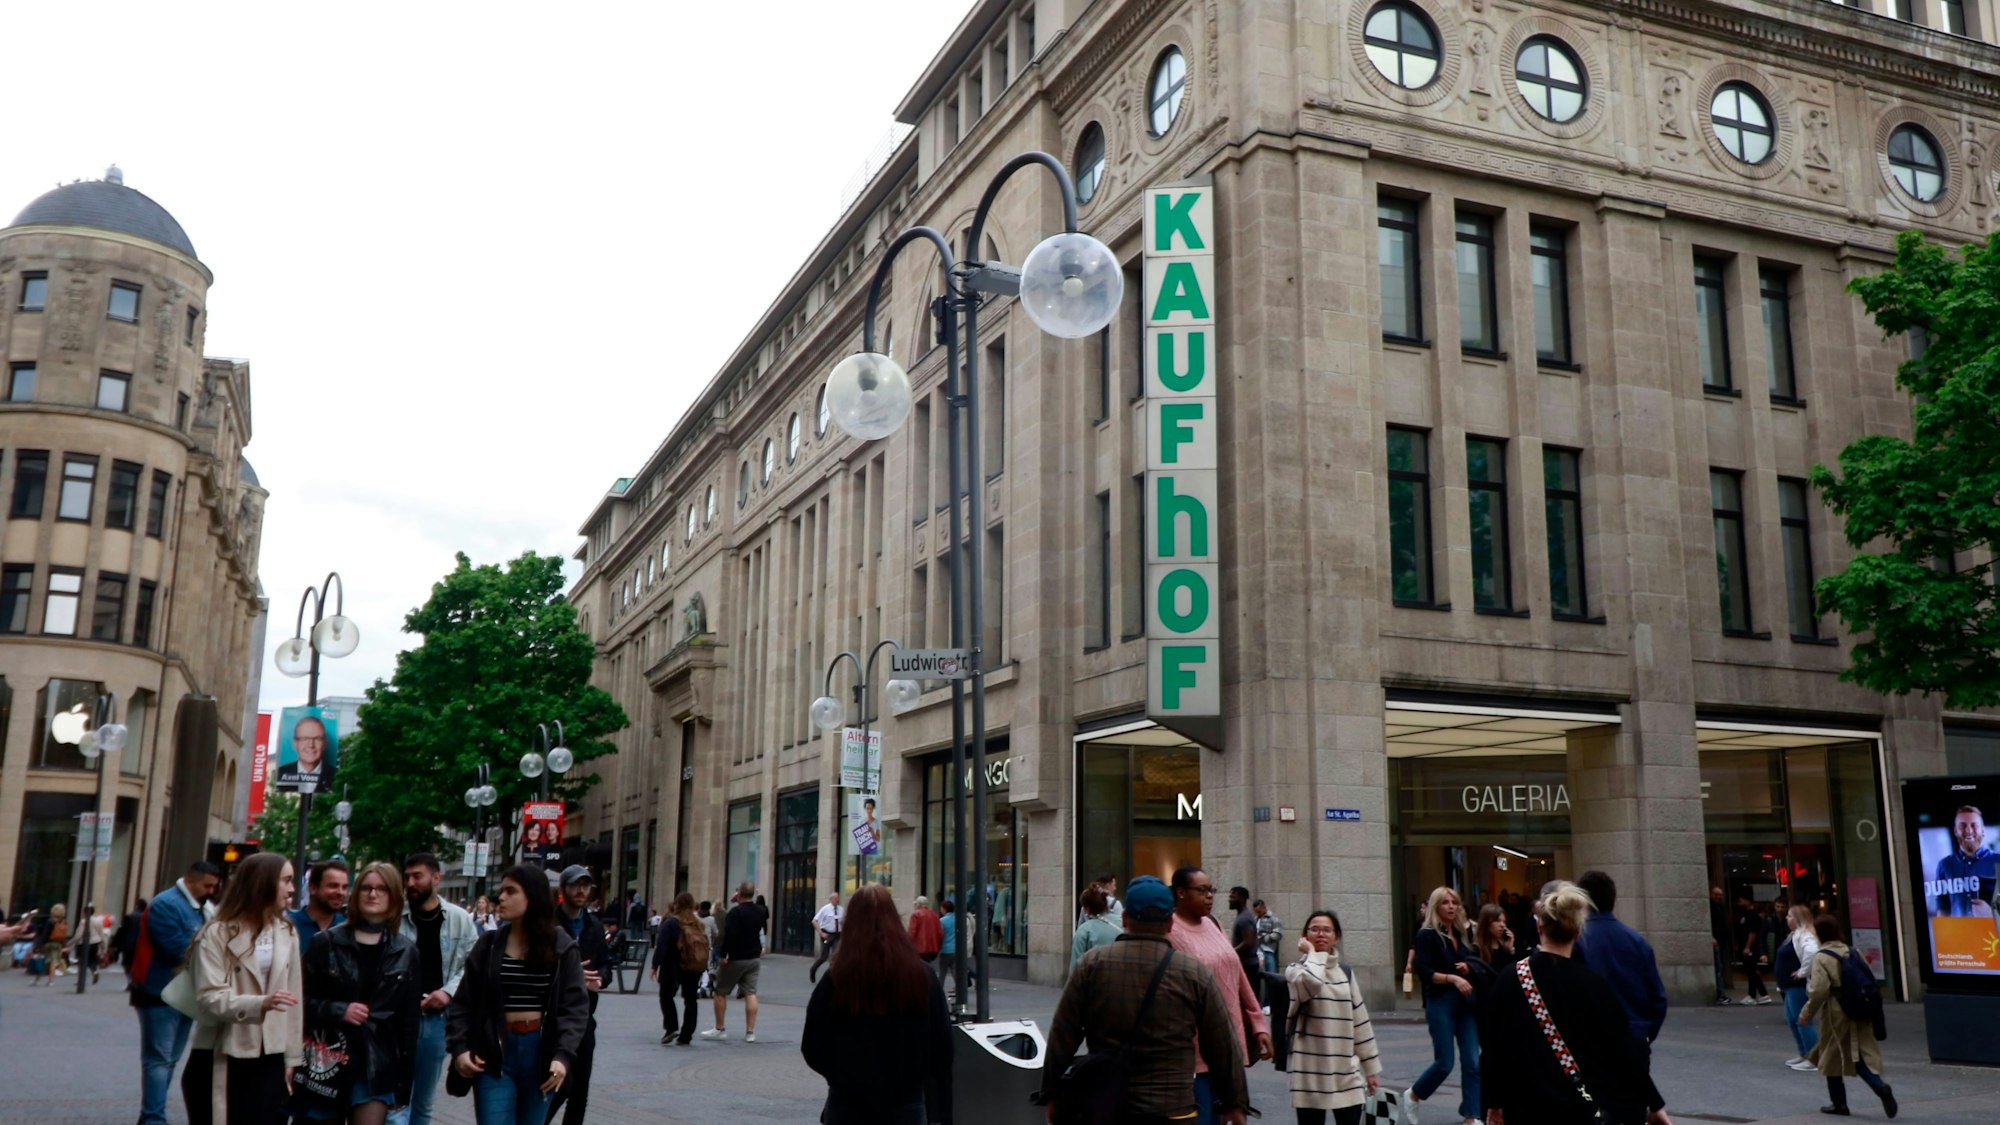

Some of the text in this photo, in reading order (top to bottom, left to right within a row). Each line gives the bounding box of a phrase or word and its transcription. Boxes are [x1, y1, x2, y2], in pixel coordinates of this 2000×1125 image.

[846, 743, 879, 756] heilar
[253, 744, 266, 782] UNIQLO
[300, 774, 318, 782] Voss
[1462, 784, 1571, 813] GALERIA
[546, 852, 561, 861] SPD
